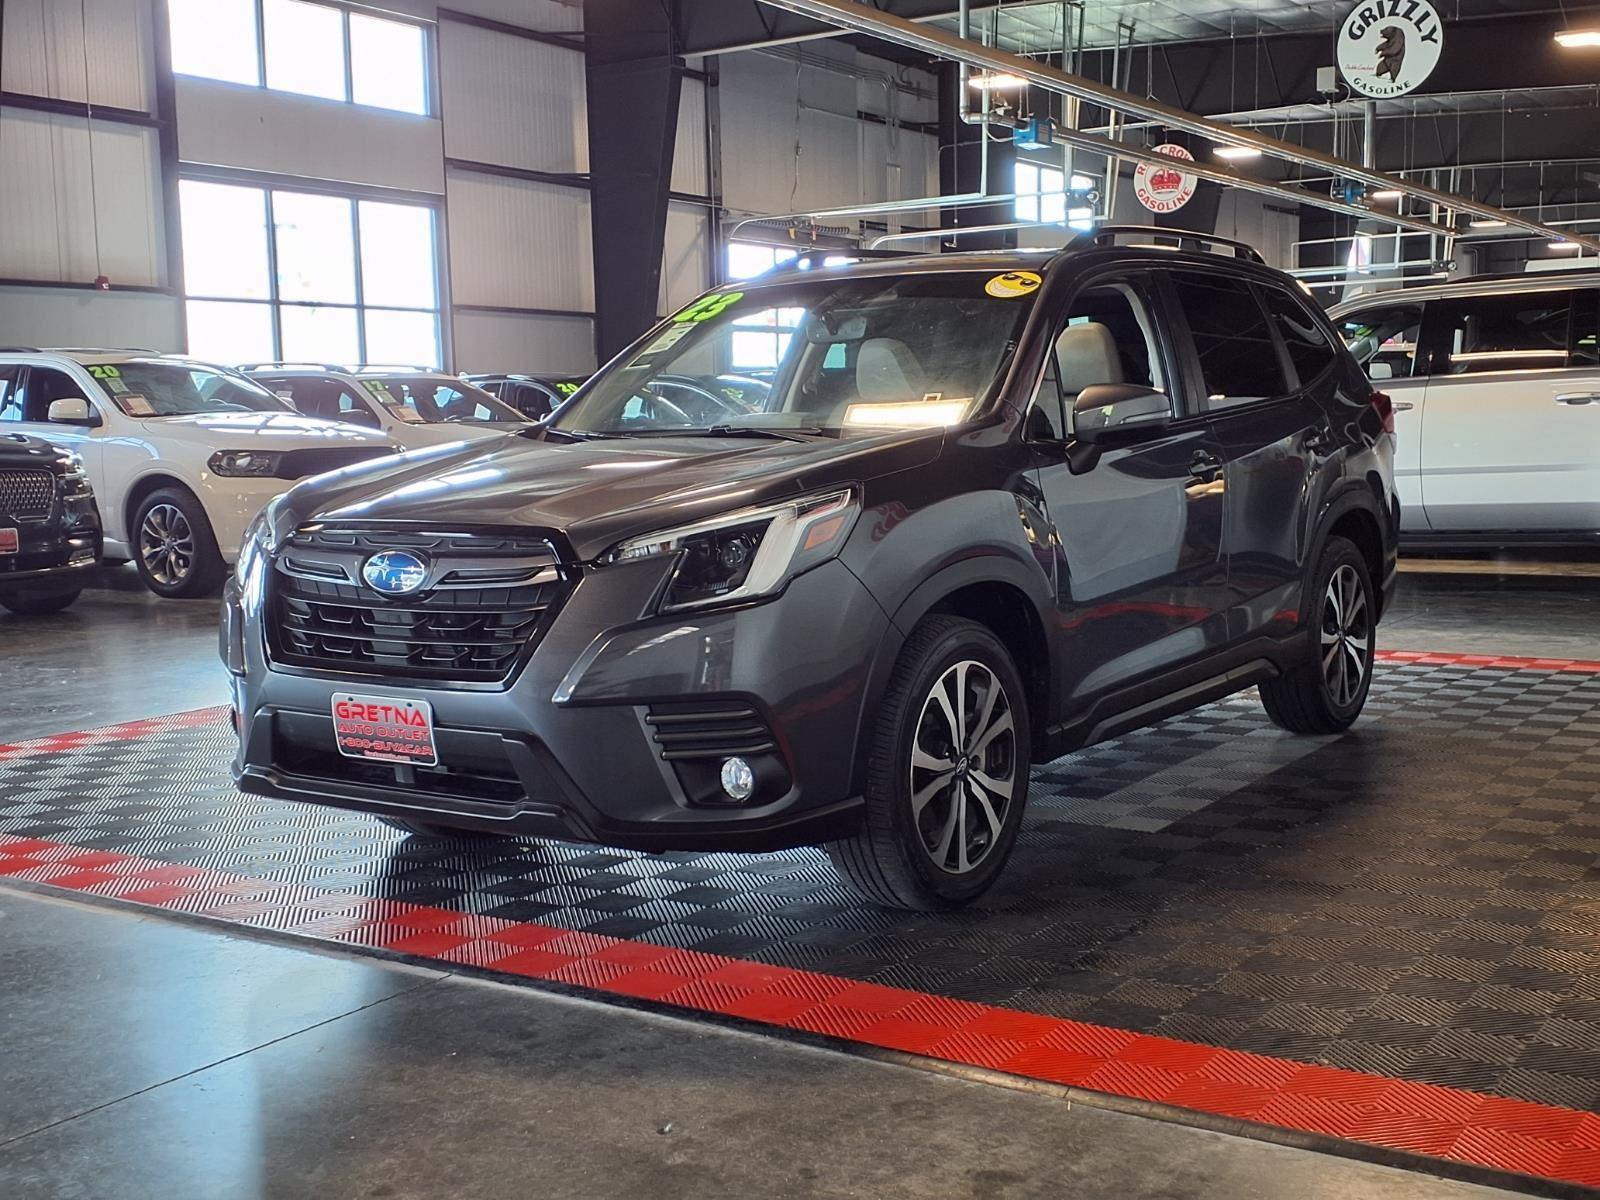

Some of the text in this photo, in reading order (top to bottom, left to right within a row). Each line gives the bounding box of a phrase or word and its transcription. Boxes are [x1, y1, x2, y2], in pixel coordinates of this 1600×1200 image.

[1348, 0, 1438, 44] GRIZZLY
[1353, 77, 1412, 95] GASOLINE
[1138, 187, 1192, 211] GASOLINE
[88, 365, 120, 378] 20
[336, 702, 427, 727] GRETNA
[338, 723, 429, 741] AUTO OUTLET
